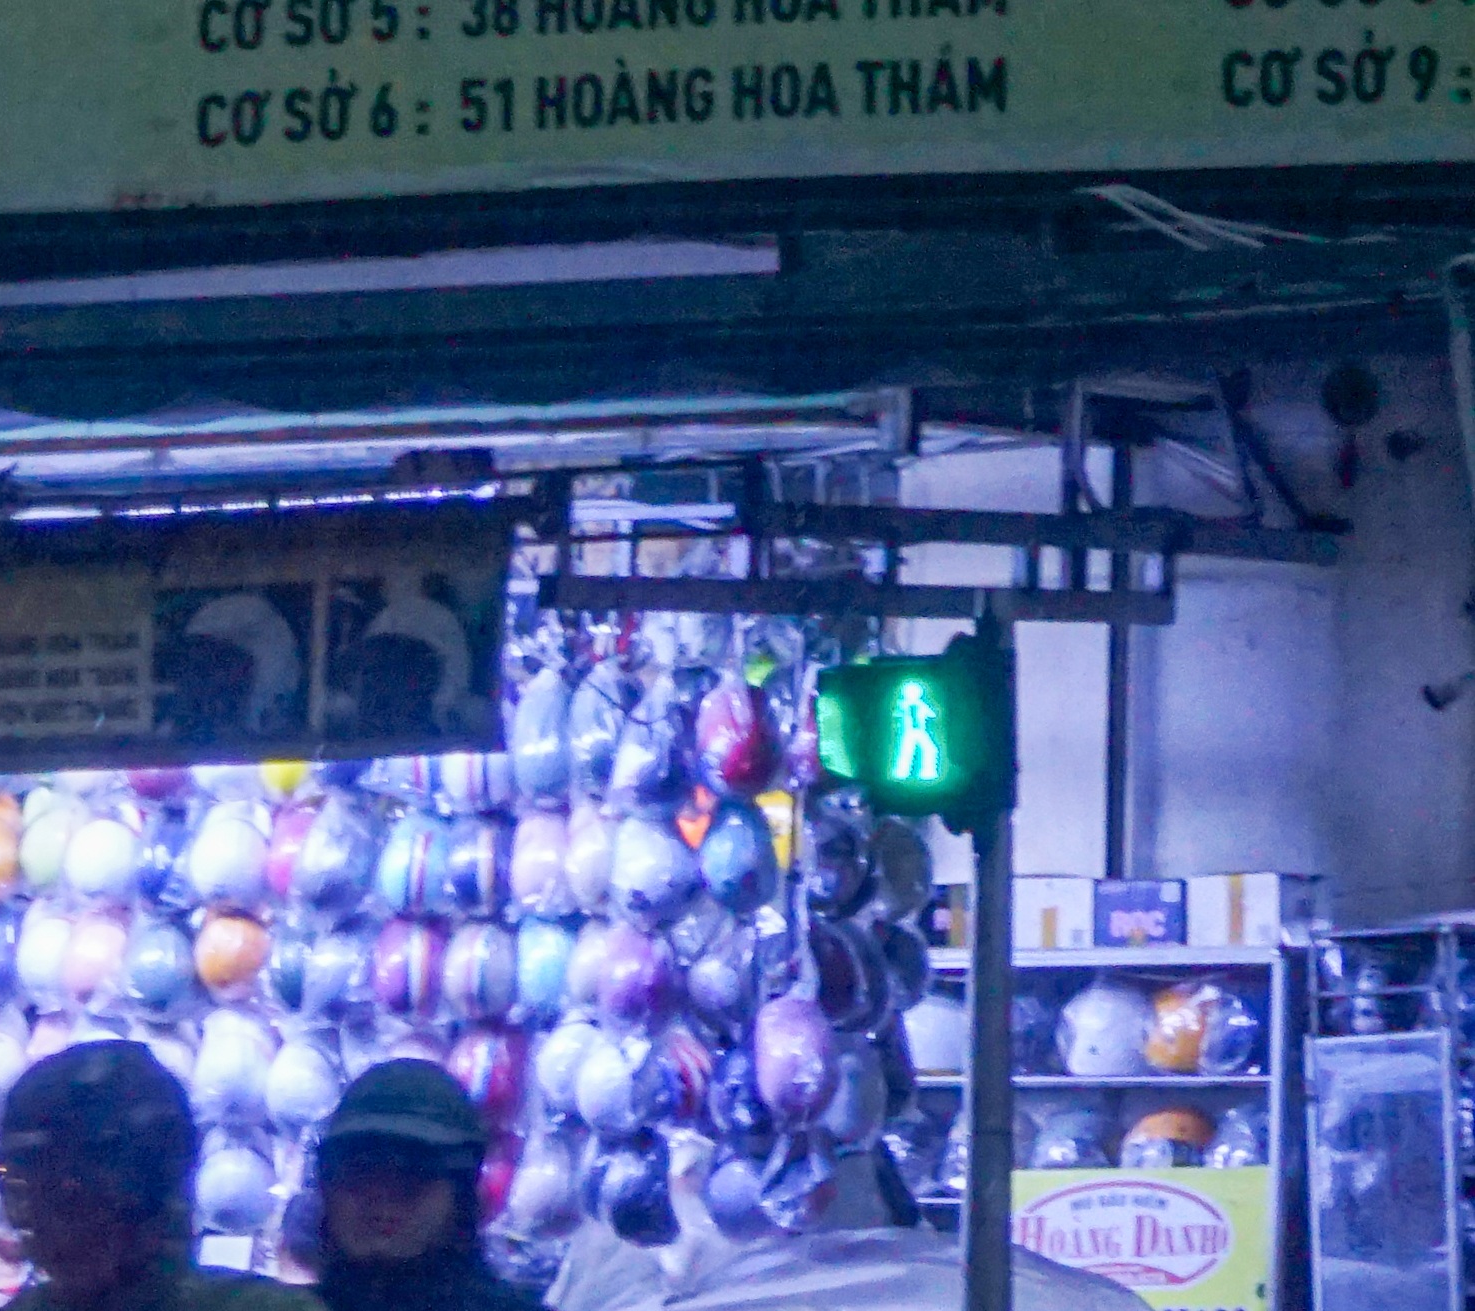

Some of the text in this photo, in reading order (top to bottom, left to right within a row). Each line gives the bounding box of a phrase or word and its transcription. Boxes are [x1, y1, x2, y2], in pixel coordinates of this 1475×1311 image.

[197, 90, 272, 146] CƠ
[284, 67, 358, 142] SỞ
[460, 77, 515, 132] 51
[536, 56, 715, 129] HOÀNG
[732, 61, 839, 120] HOA
[1222, 46, 1303, 106] CƠ
[1316, 29, 1396, 105] SỞ
